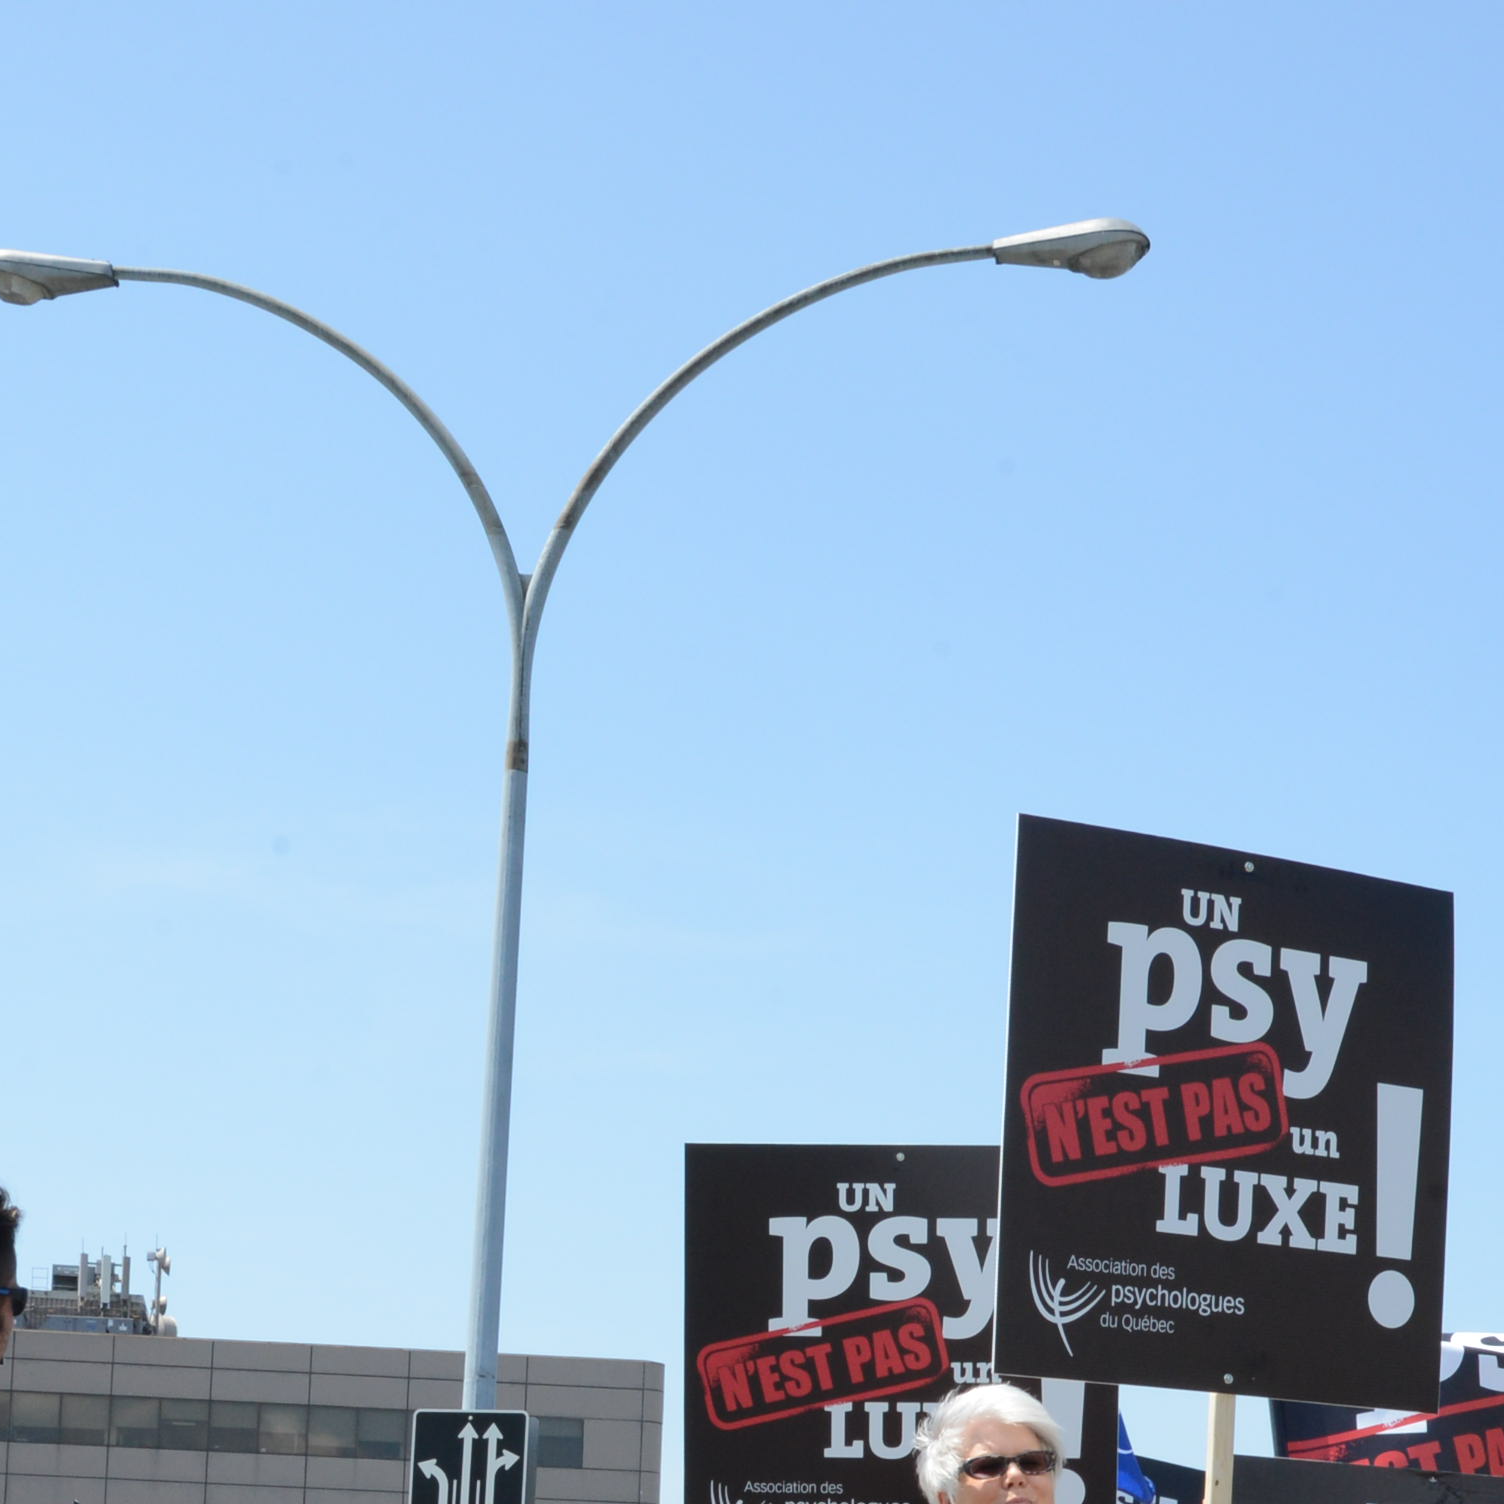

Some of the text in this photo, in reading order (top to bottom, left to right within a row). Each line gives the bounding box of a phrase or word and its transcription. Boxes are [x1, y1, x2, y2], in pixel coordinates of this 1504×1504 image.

[1181, 888, 1242, 931] UN
[1101, 921, 1368, 1099] psy
[1042, 1072, 1272, 1164] N'EST PAS
[1291, 1125, 1340, 1160] un
[837, 1182, 895, 1212] UN
[1155, 1163, 1359, 1255] LUXE
[768, 1215, 998, 1340] psy
[1067, 1254, 1175, 1280] Association des
[1111, 1283, 1245, 1317] psychologues
[1100, 1312, 1175, 1335] du Québec
[716, 1322, 933, 1412] N'EST PAS
[823, 1402, 934, 1459] LU
[744, 1480, 844, 1495] Association des
